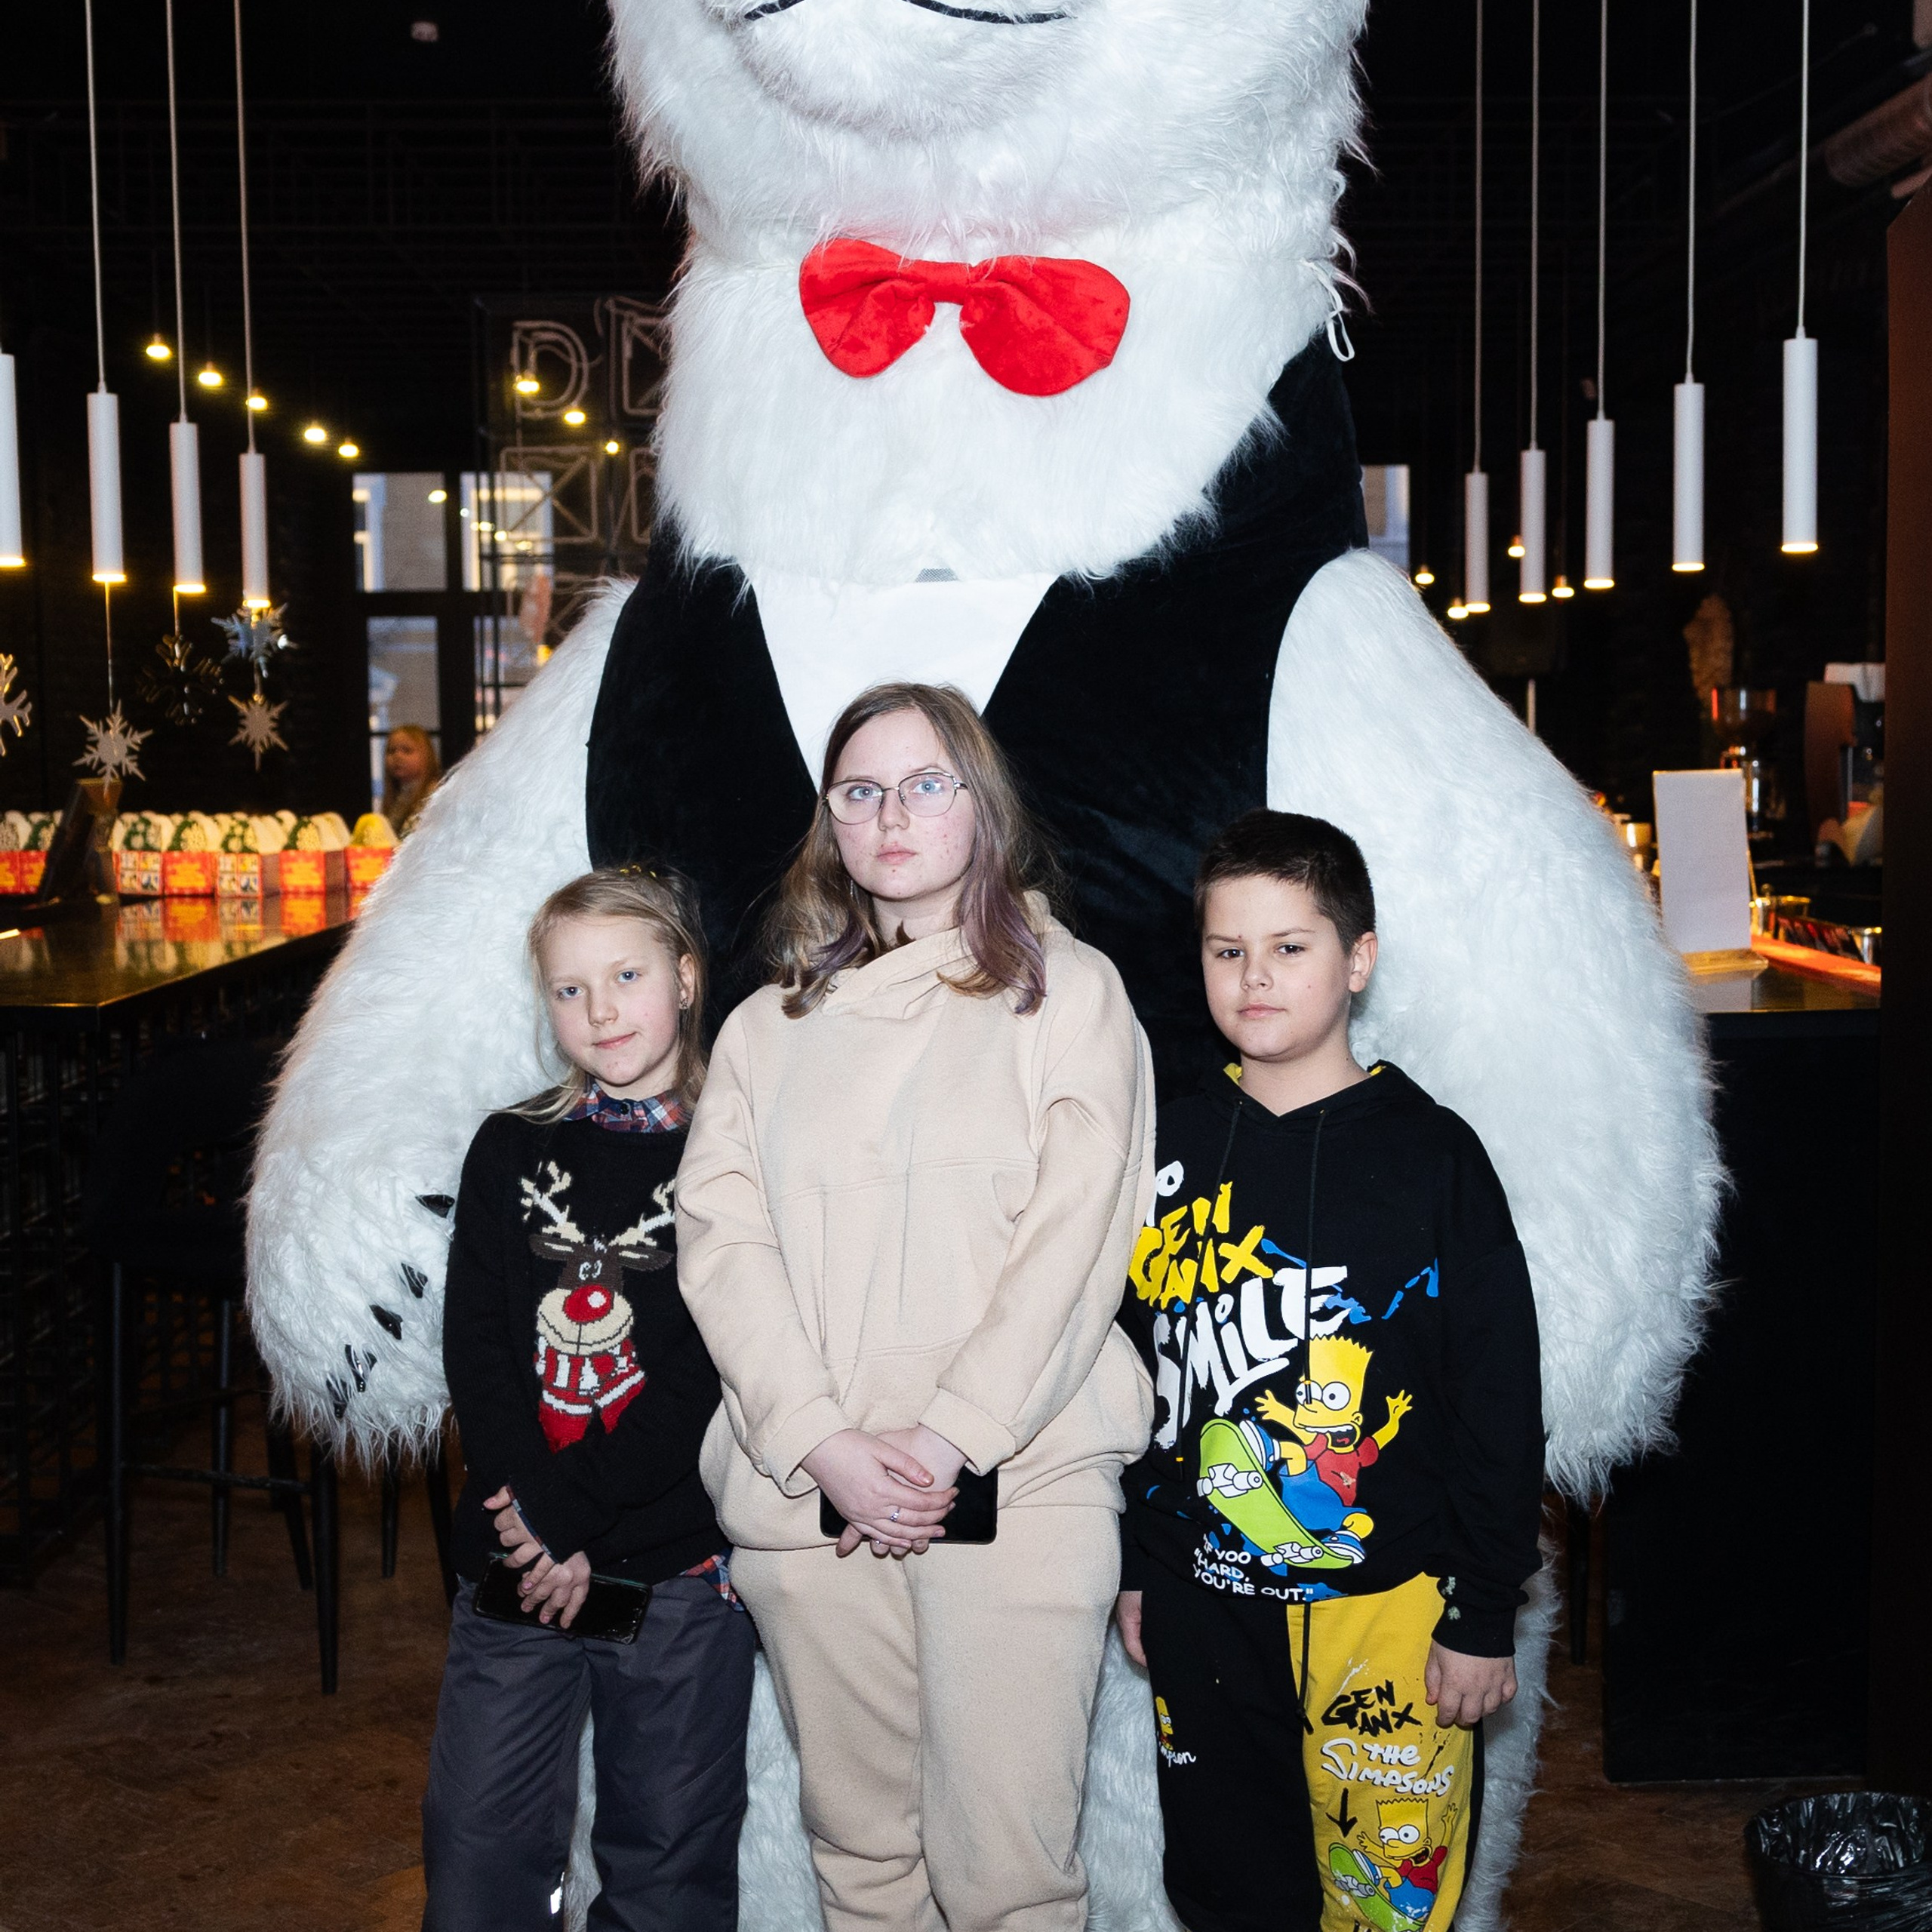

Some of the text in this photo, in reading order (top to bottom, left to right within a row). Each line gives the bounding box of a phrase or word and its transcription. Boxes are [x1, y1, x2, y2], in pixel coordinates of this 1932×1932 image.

[1321, 1679, 1395, 1730] GEN
[1359, 1703, 1423, 1737] ANX
[1321, 1737, 1454, 1798] SIMPSONS
